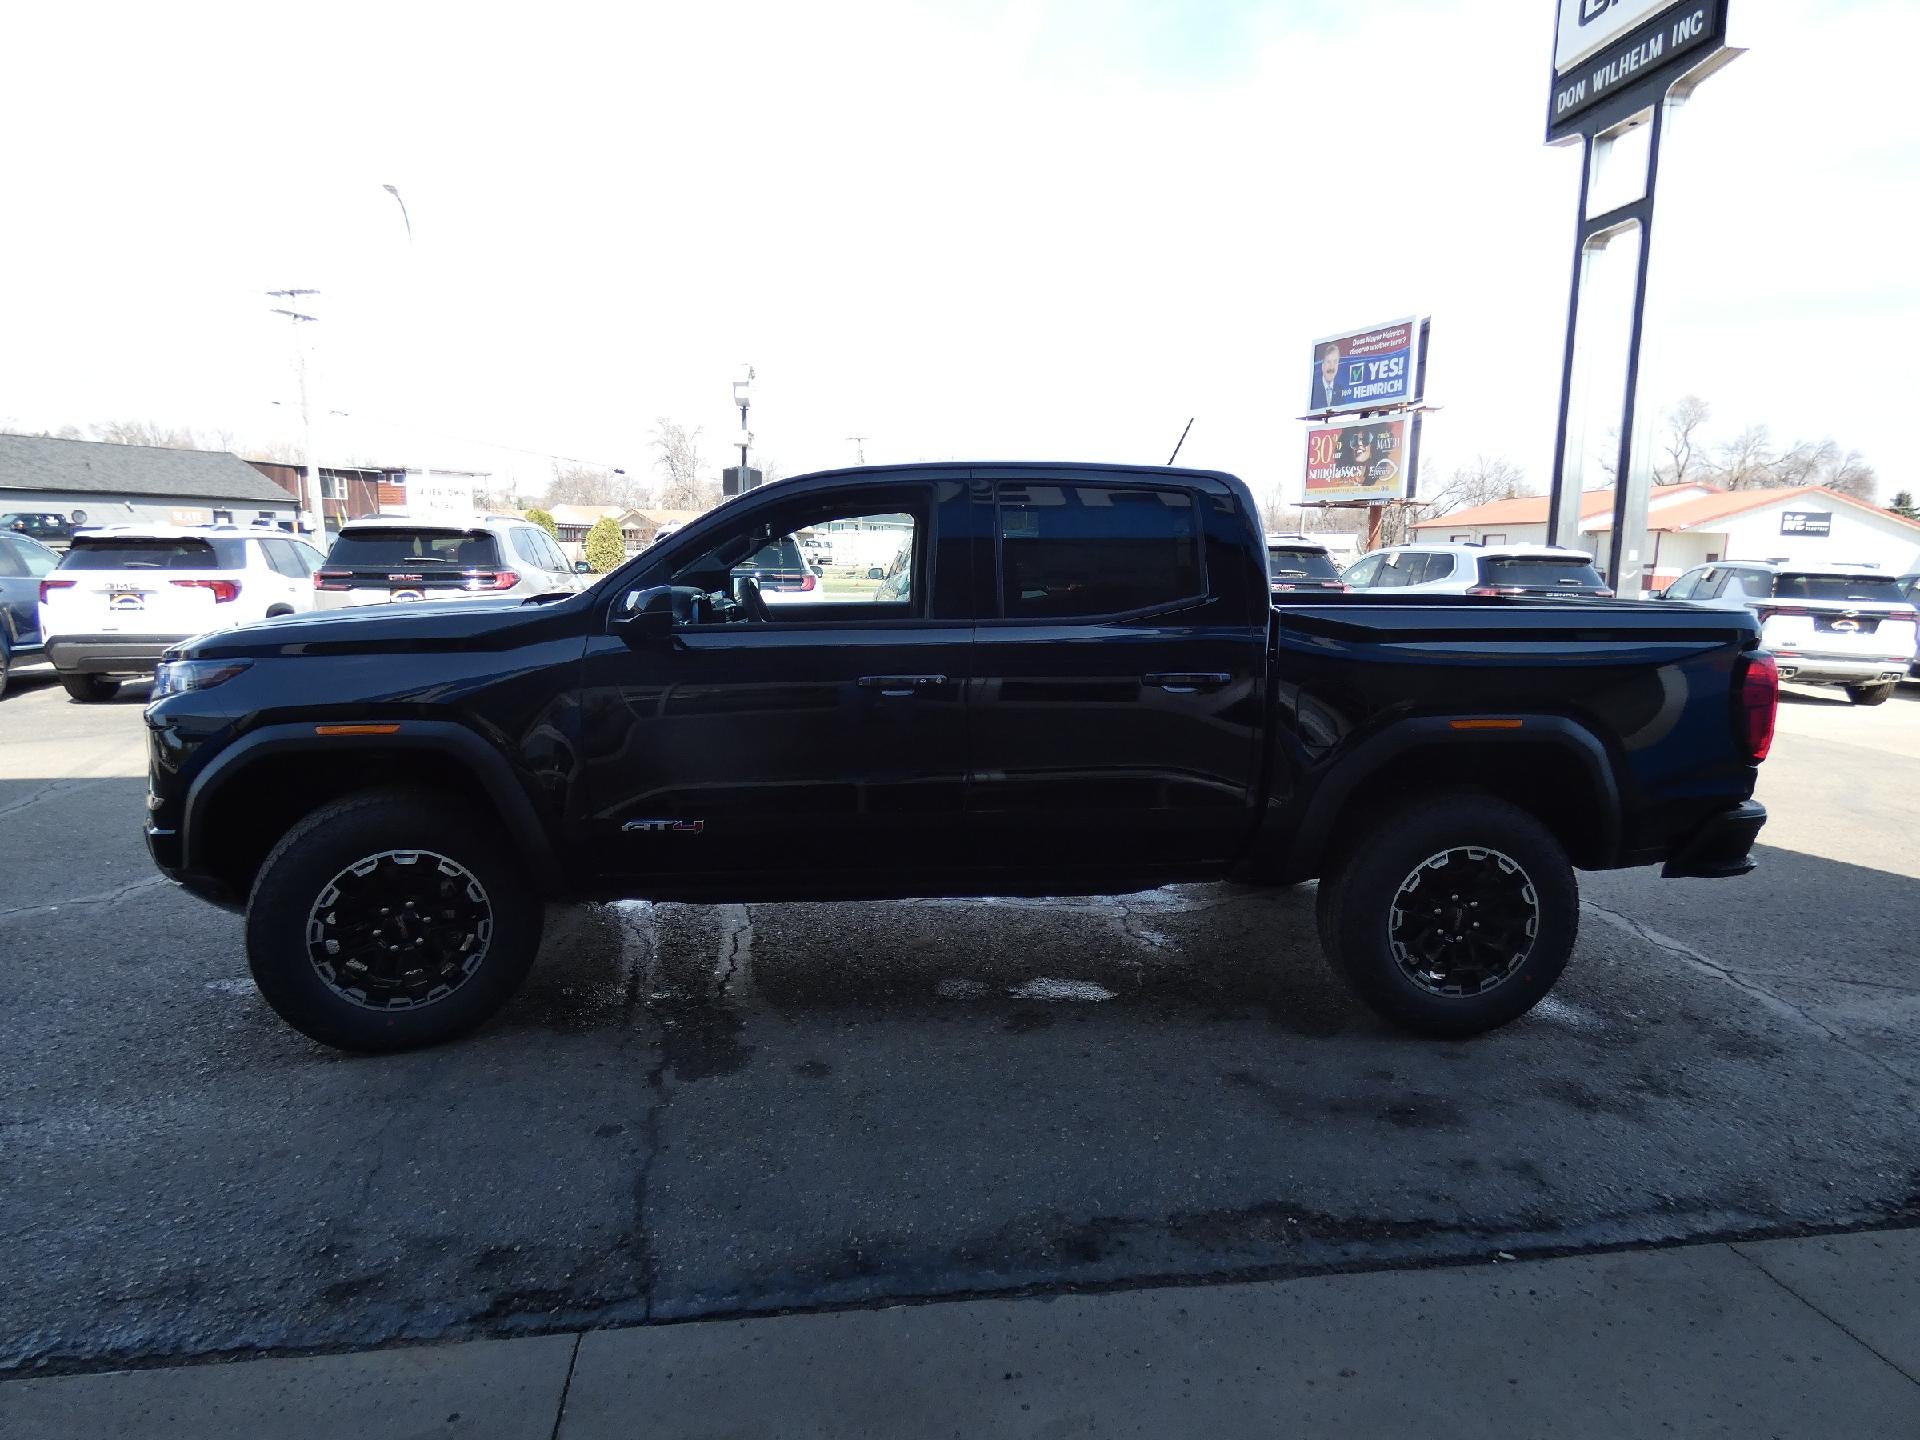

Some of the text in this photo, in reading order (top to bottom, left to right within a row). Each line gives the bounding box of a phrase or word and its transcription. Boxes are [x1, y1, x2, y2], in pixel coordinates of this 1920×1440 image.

[1557, 10, 1704, 114] DON WILHELM INC
[1368, 356, 1405, 381] YES!
[1353, 379, 1403, 398] HEINRICH
[1376, 437, 1392, 450] MAY
[621, 820, 704, 833] AT4
